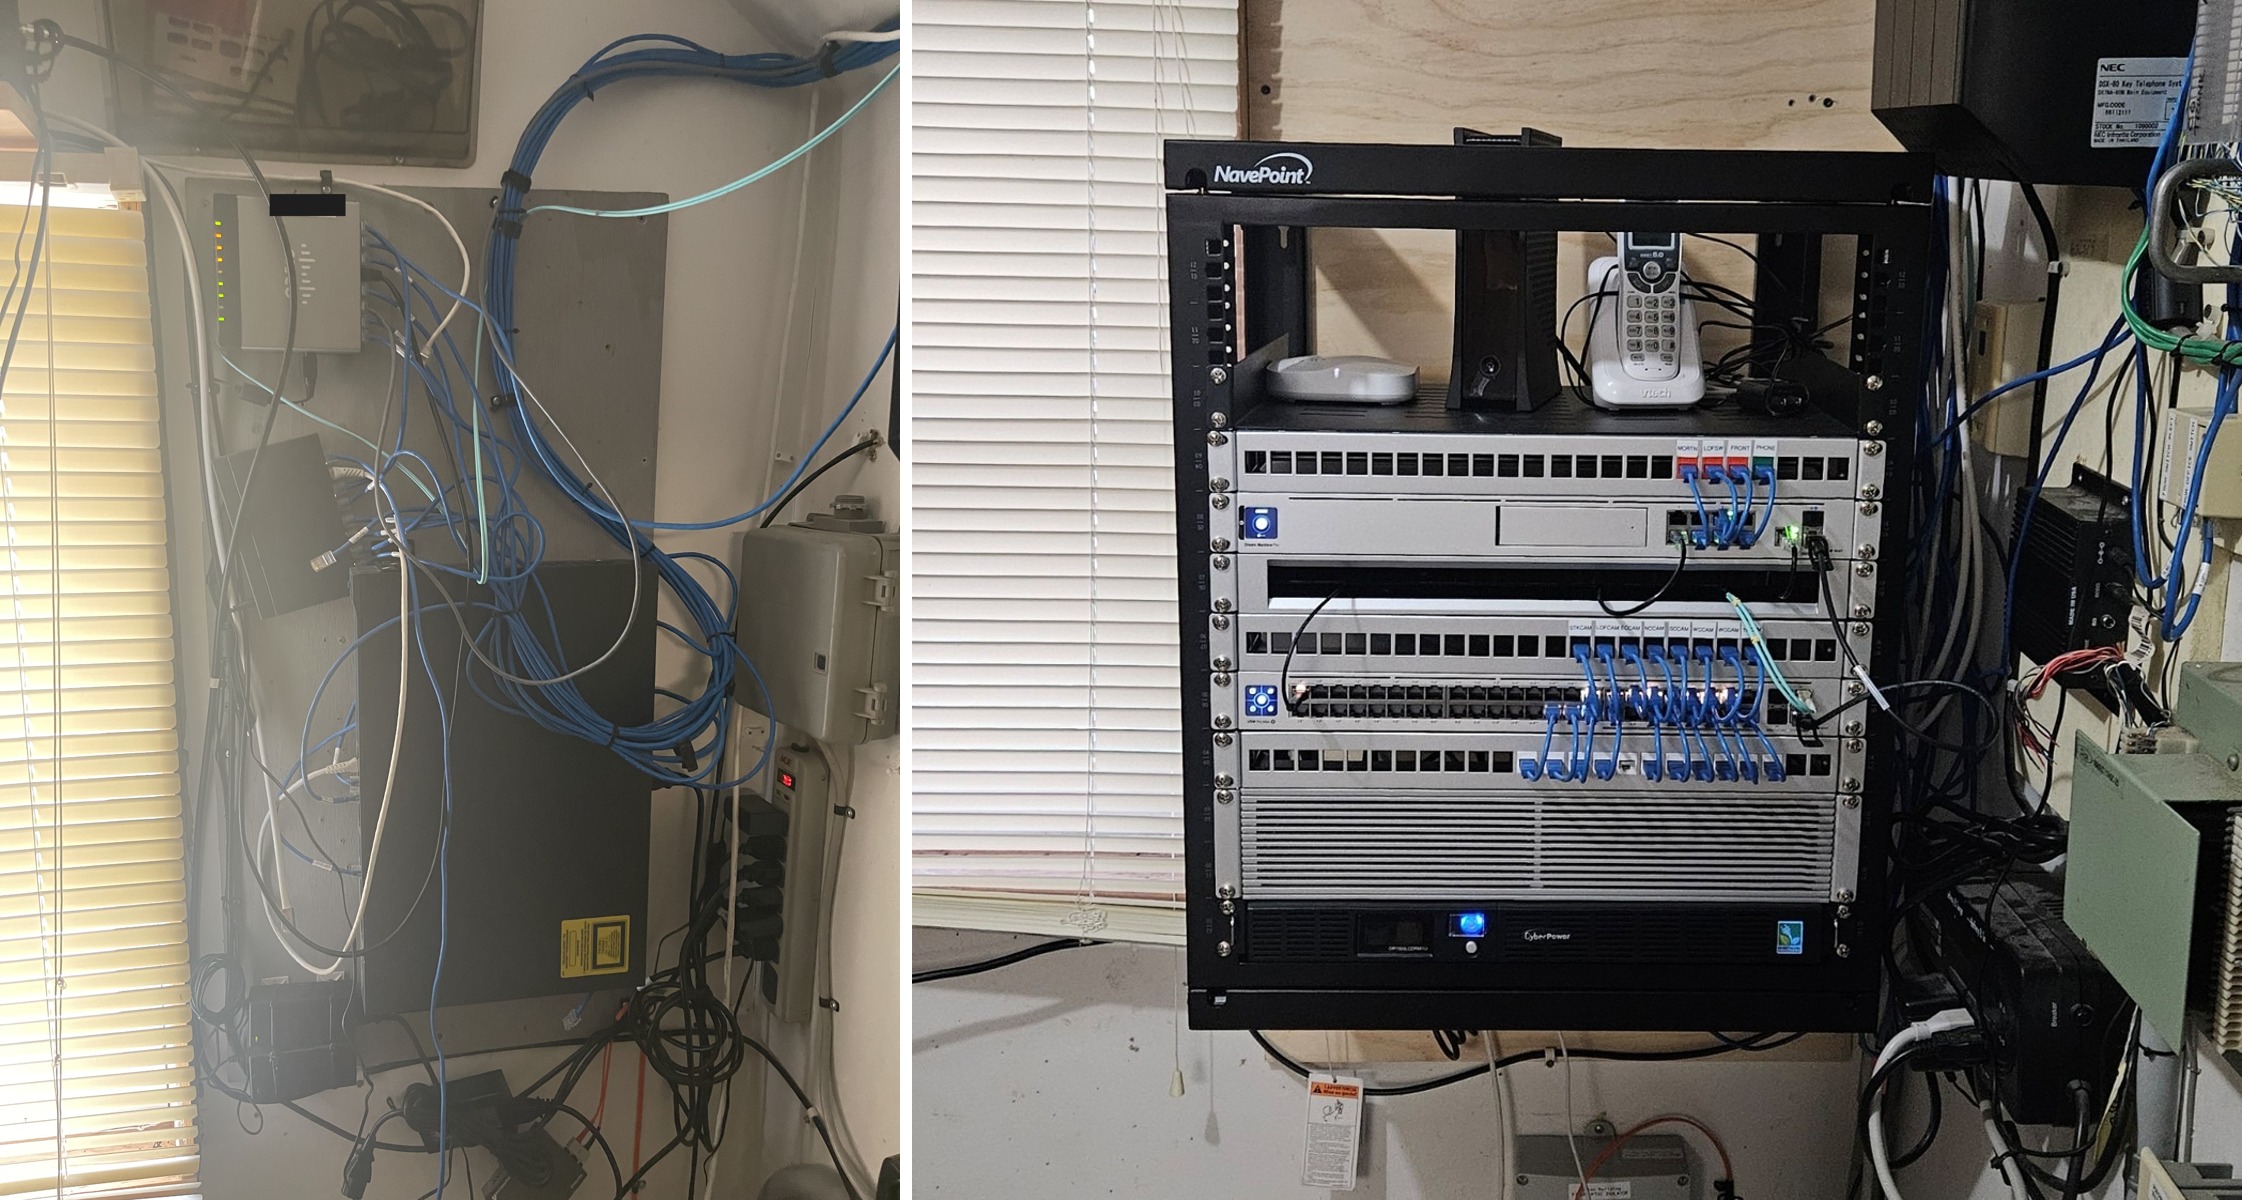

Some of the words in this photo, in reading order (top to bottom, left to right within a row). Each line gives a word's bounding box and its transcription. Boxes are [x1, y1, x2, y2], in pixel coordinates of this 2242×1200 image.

[2100, 63, 2126, 72] NEC
[2122, 80, 2133, 88] Key
[2136, 80, 2166, 88] Telephone
[1213, 165, 1305, 185] NavePoint
[2068, 608, 2076, 626] MADE
[1524, 929, 1571, 942] CyberPower
